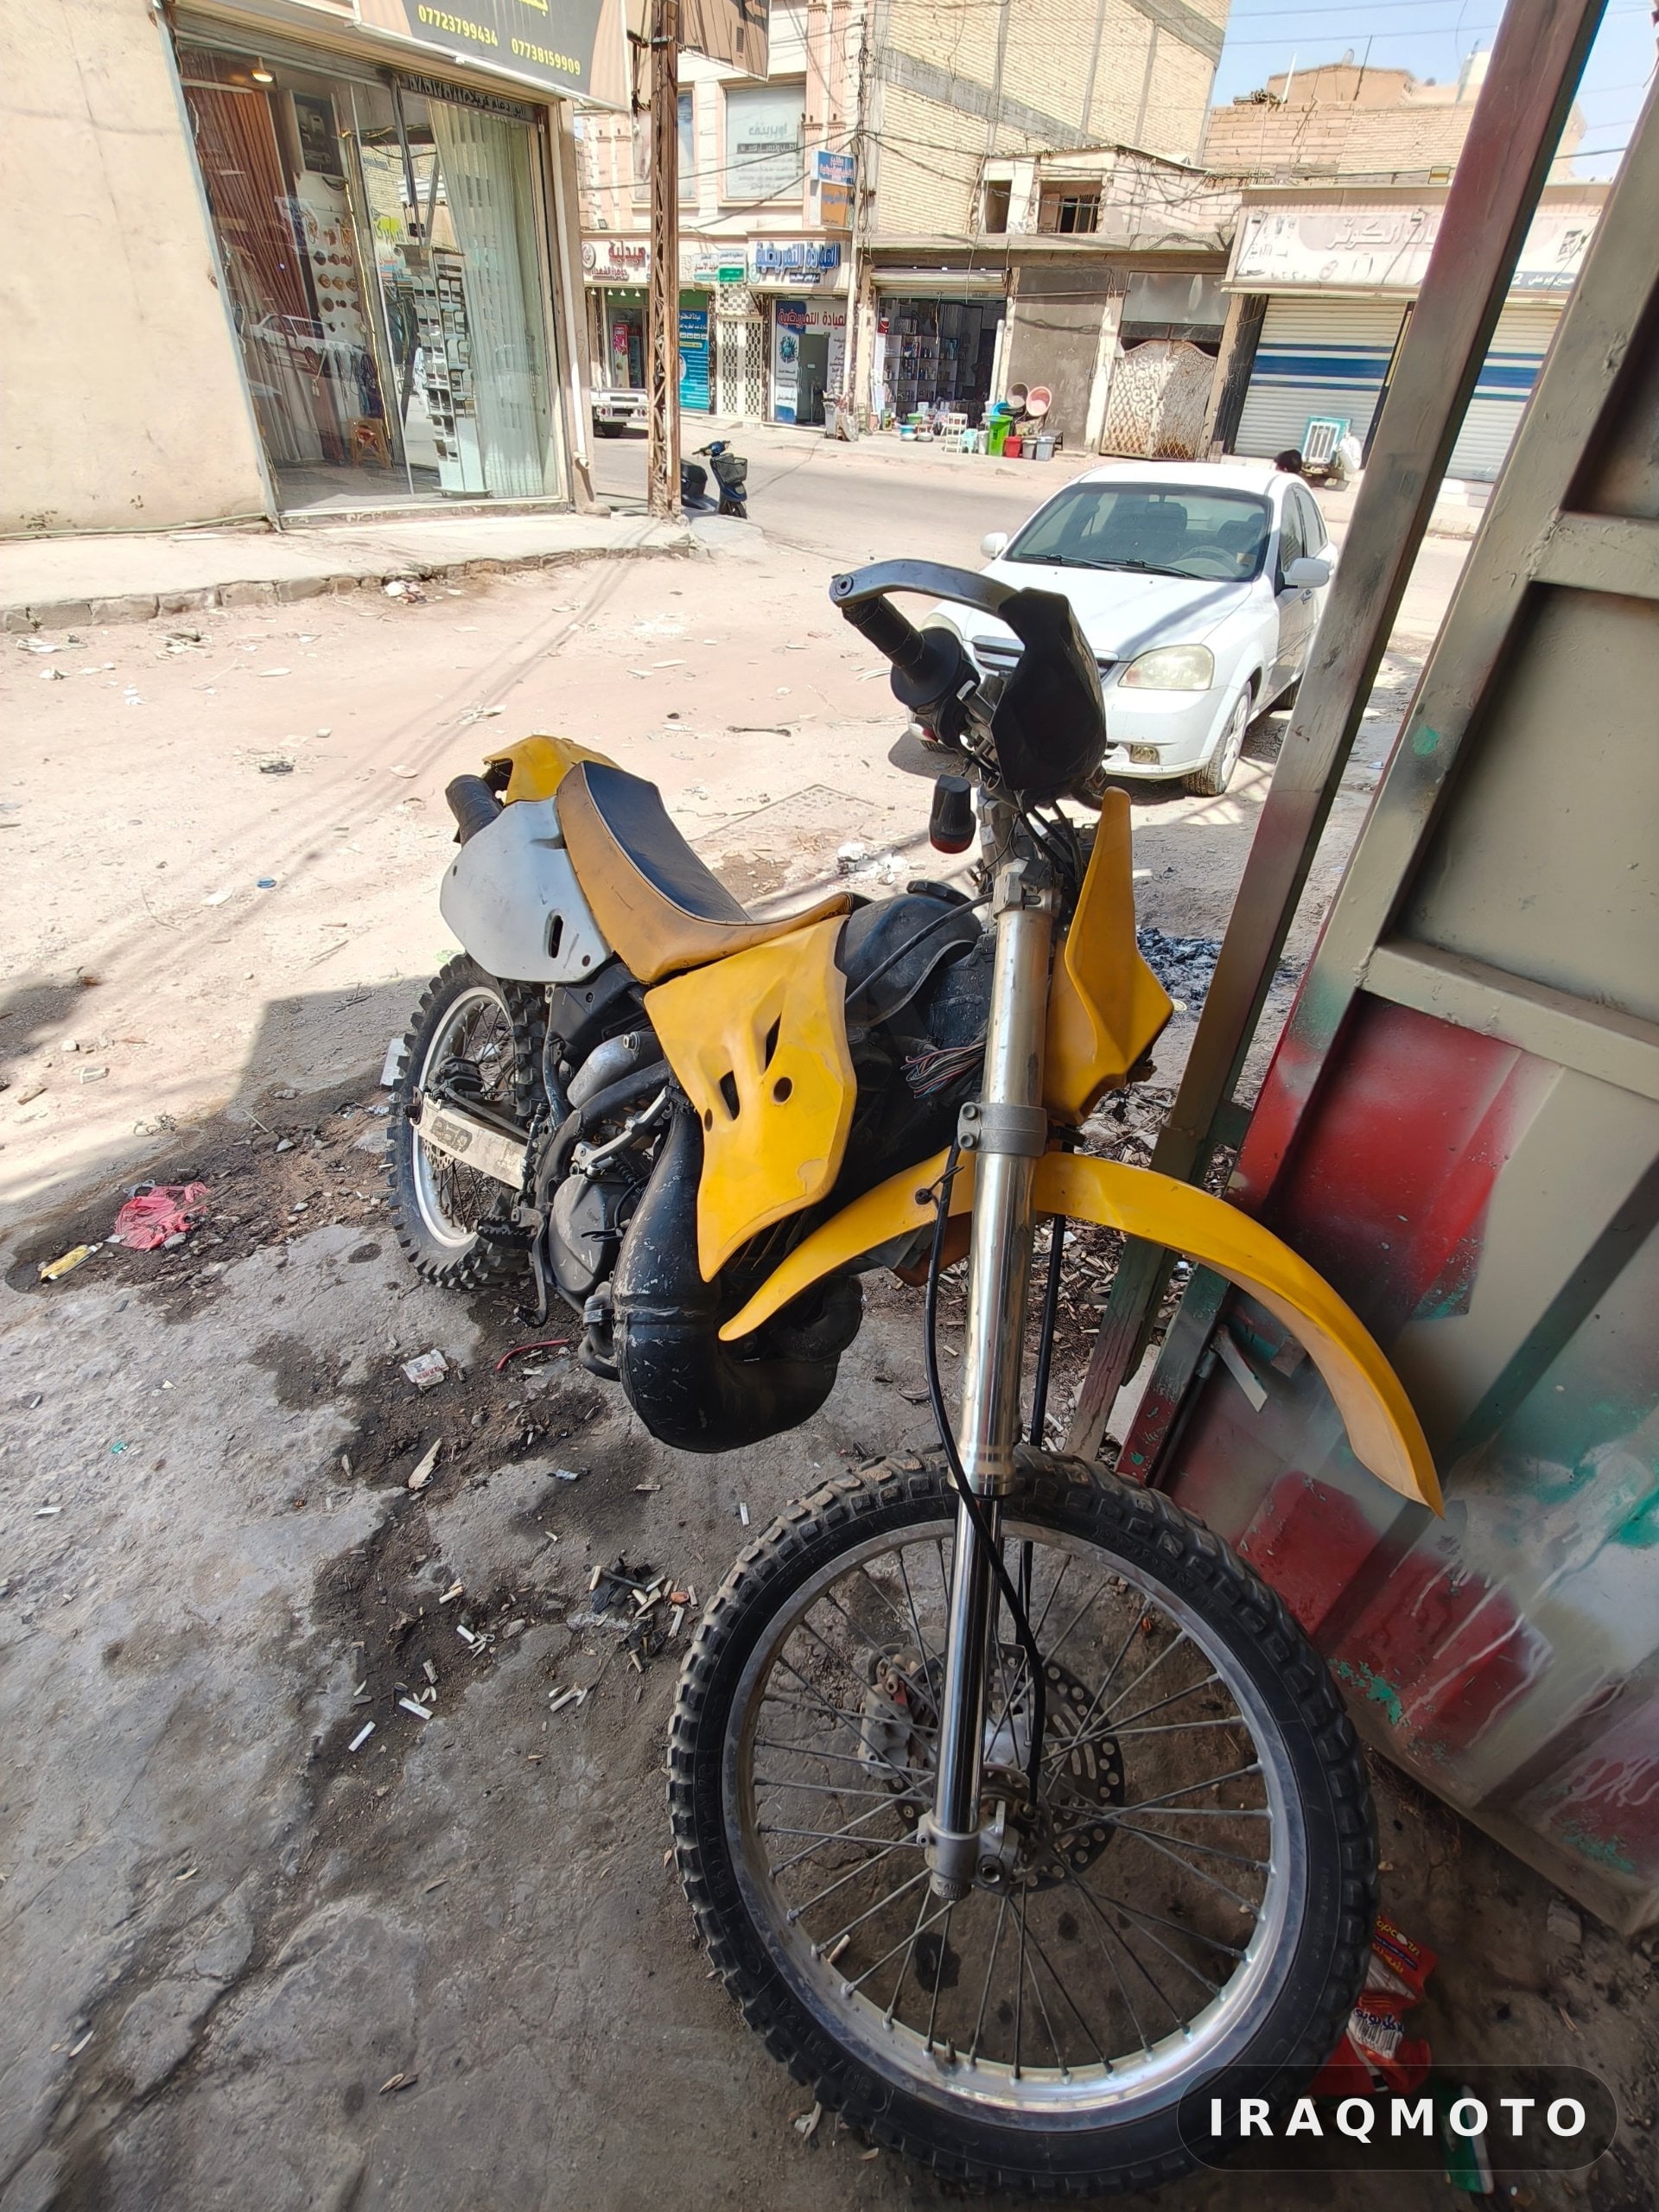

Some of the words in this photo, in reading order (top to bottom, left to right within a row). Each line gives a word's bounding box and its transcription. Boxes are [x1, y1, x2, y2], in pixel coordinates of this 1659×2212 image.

[418, 4, 498, 47] 07723799434
[511, 38, 581, 76] 07738159909
[1325, 217, 1404, 251] الكوثر
[756, 241, 804, 274] التمريضية
[804, 242, 841, 274] العيادة
[779, 308, 819, 327] التمريضية
